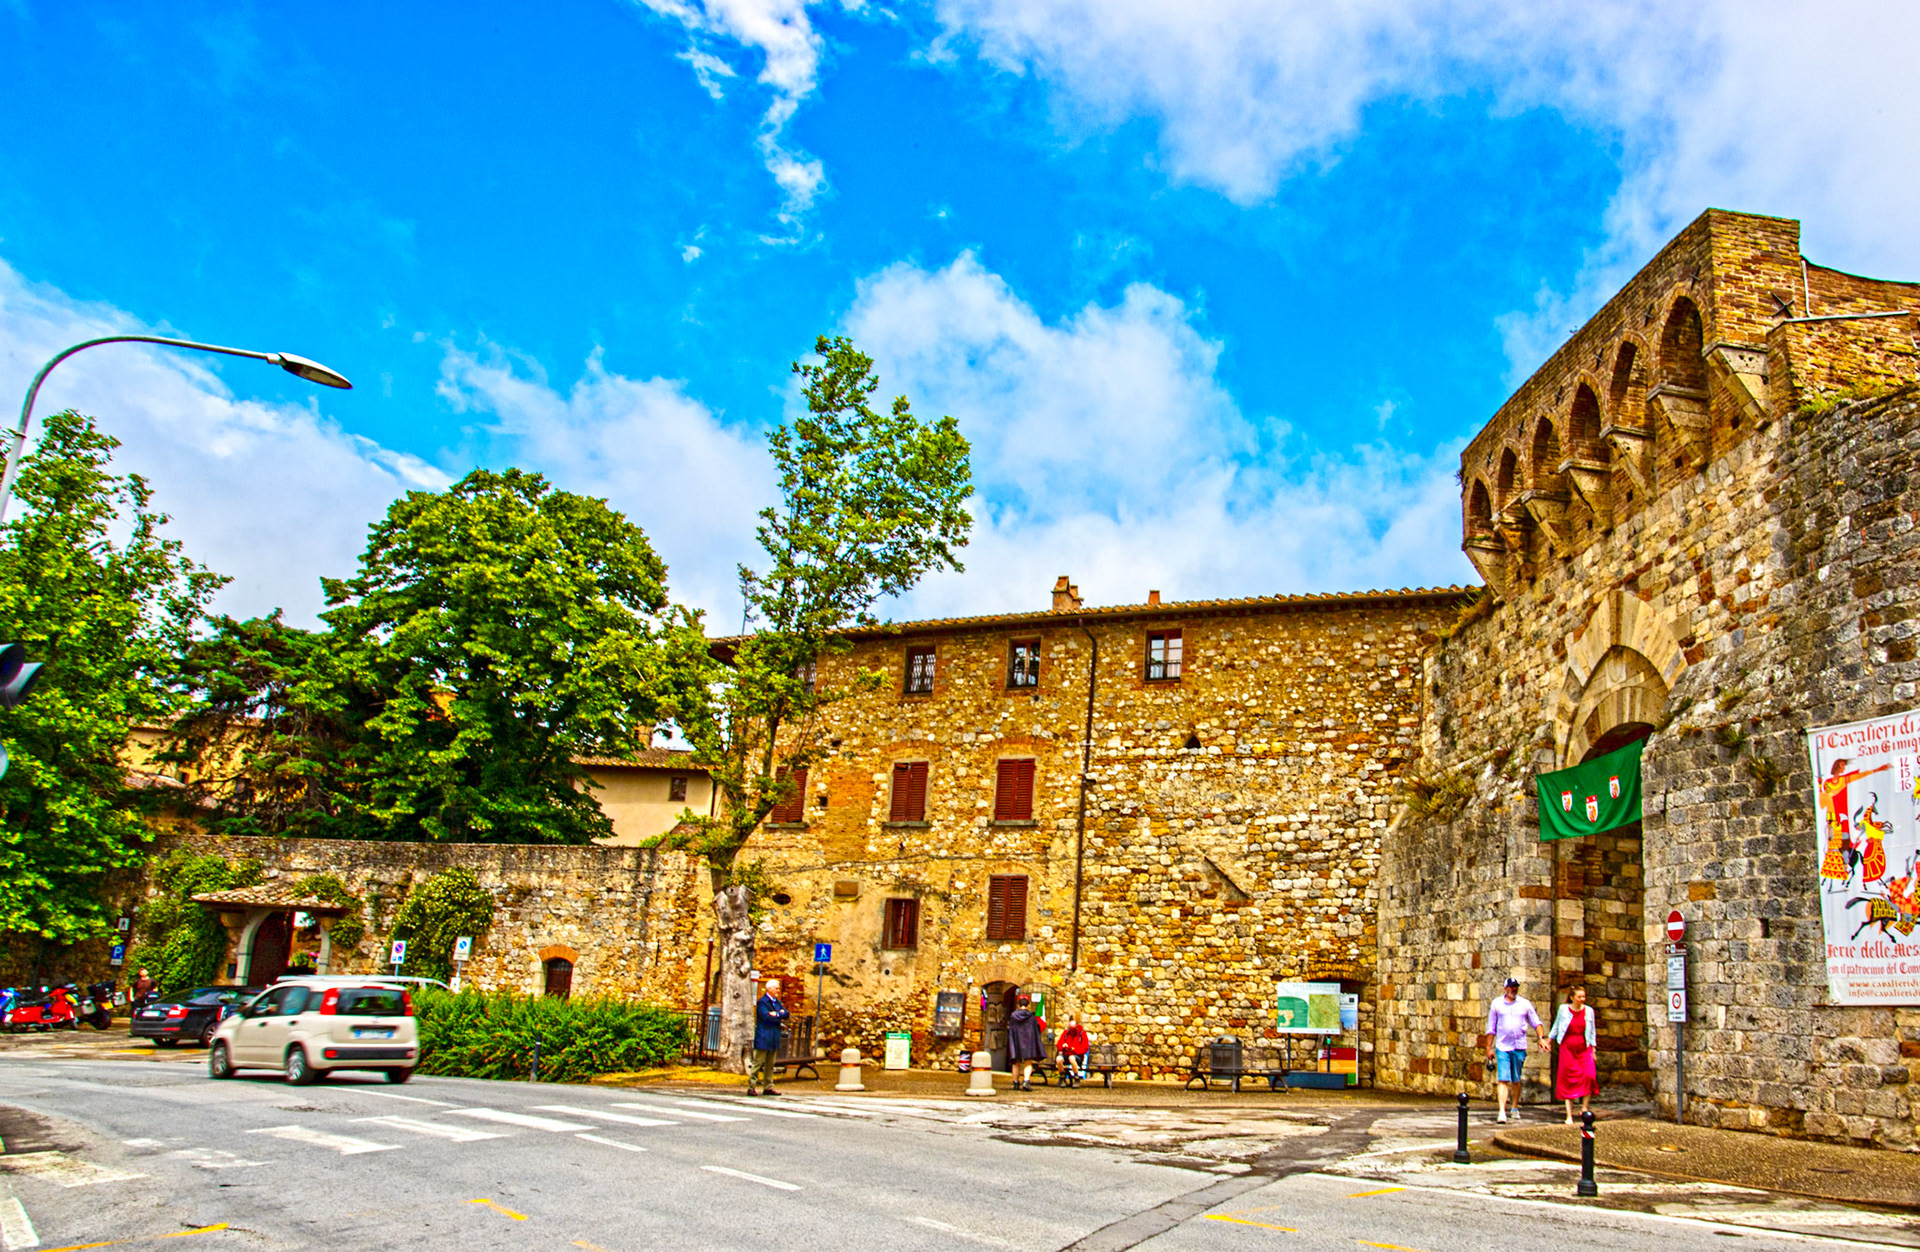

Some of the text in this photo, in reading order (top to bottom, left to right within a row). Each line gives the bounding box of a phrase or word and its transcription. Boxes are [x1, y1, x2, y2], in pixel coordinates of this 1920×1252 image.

[1827, 723, 1896, 748] Cavalieri
[1900, 714, 1914, 735] di
[1858, 737, 1920, 757] San Gimig
[1900, 768, 1911, 779] 15
[1901, 779, 1912, 791] 16
[113, 946, 123, 957] P
[1861, 940, 1890, 958] delle
[1891, 943, 1920, 959] Mes
[1886, 963, 1897, 974] del
[1849, 980, 1920, 988] www.cavalieridi
